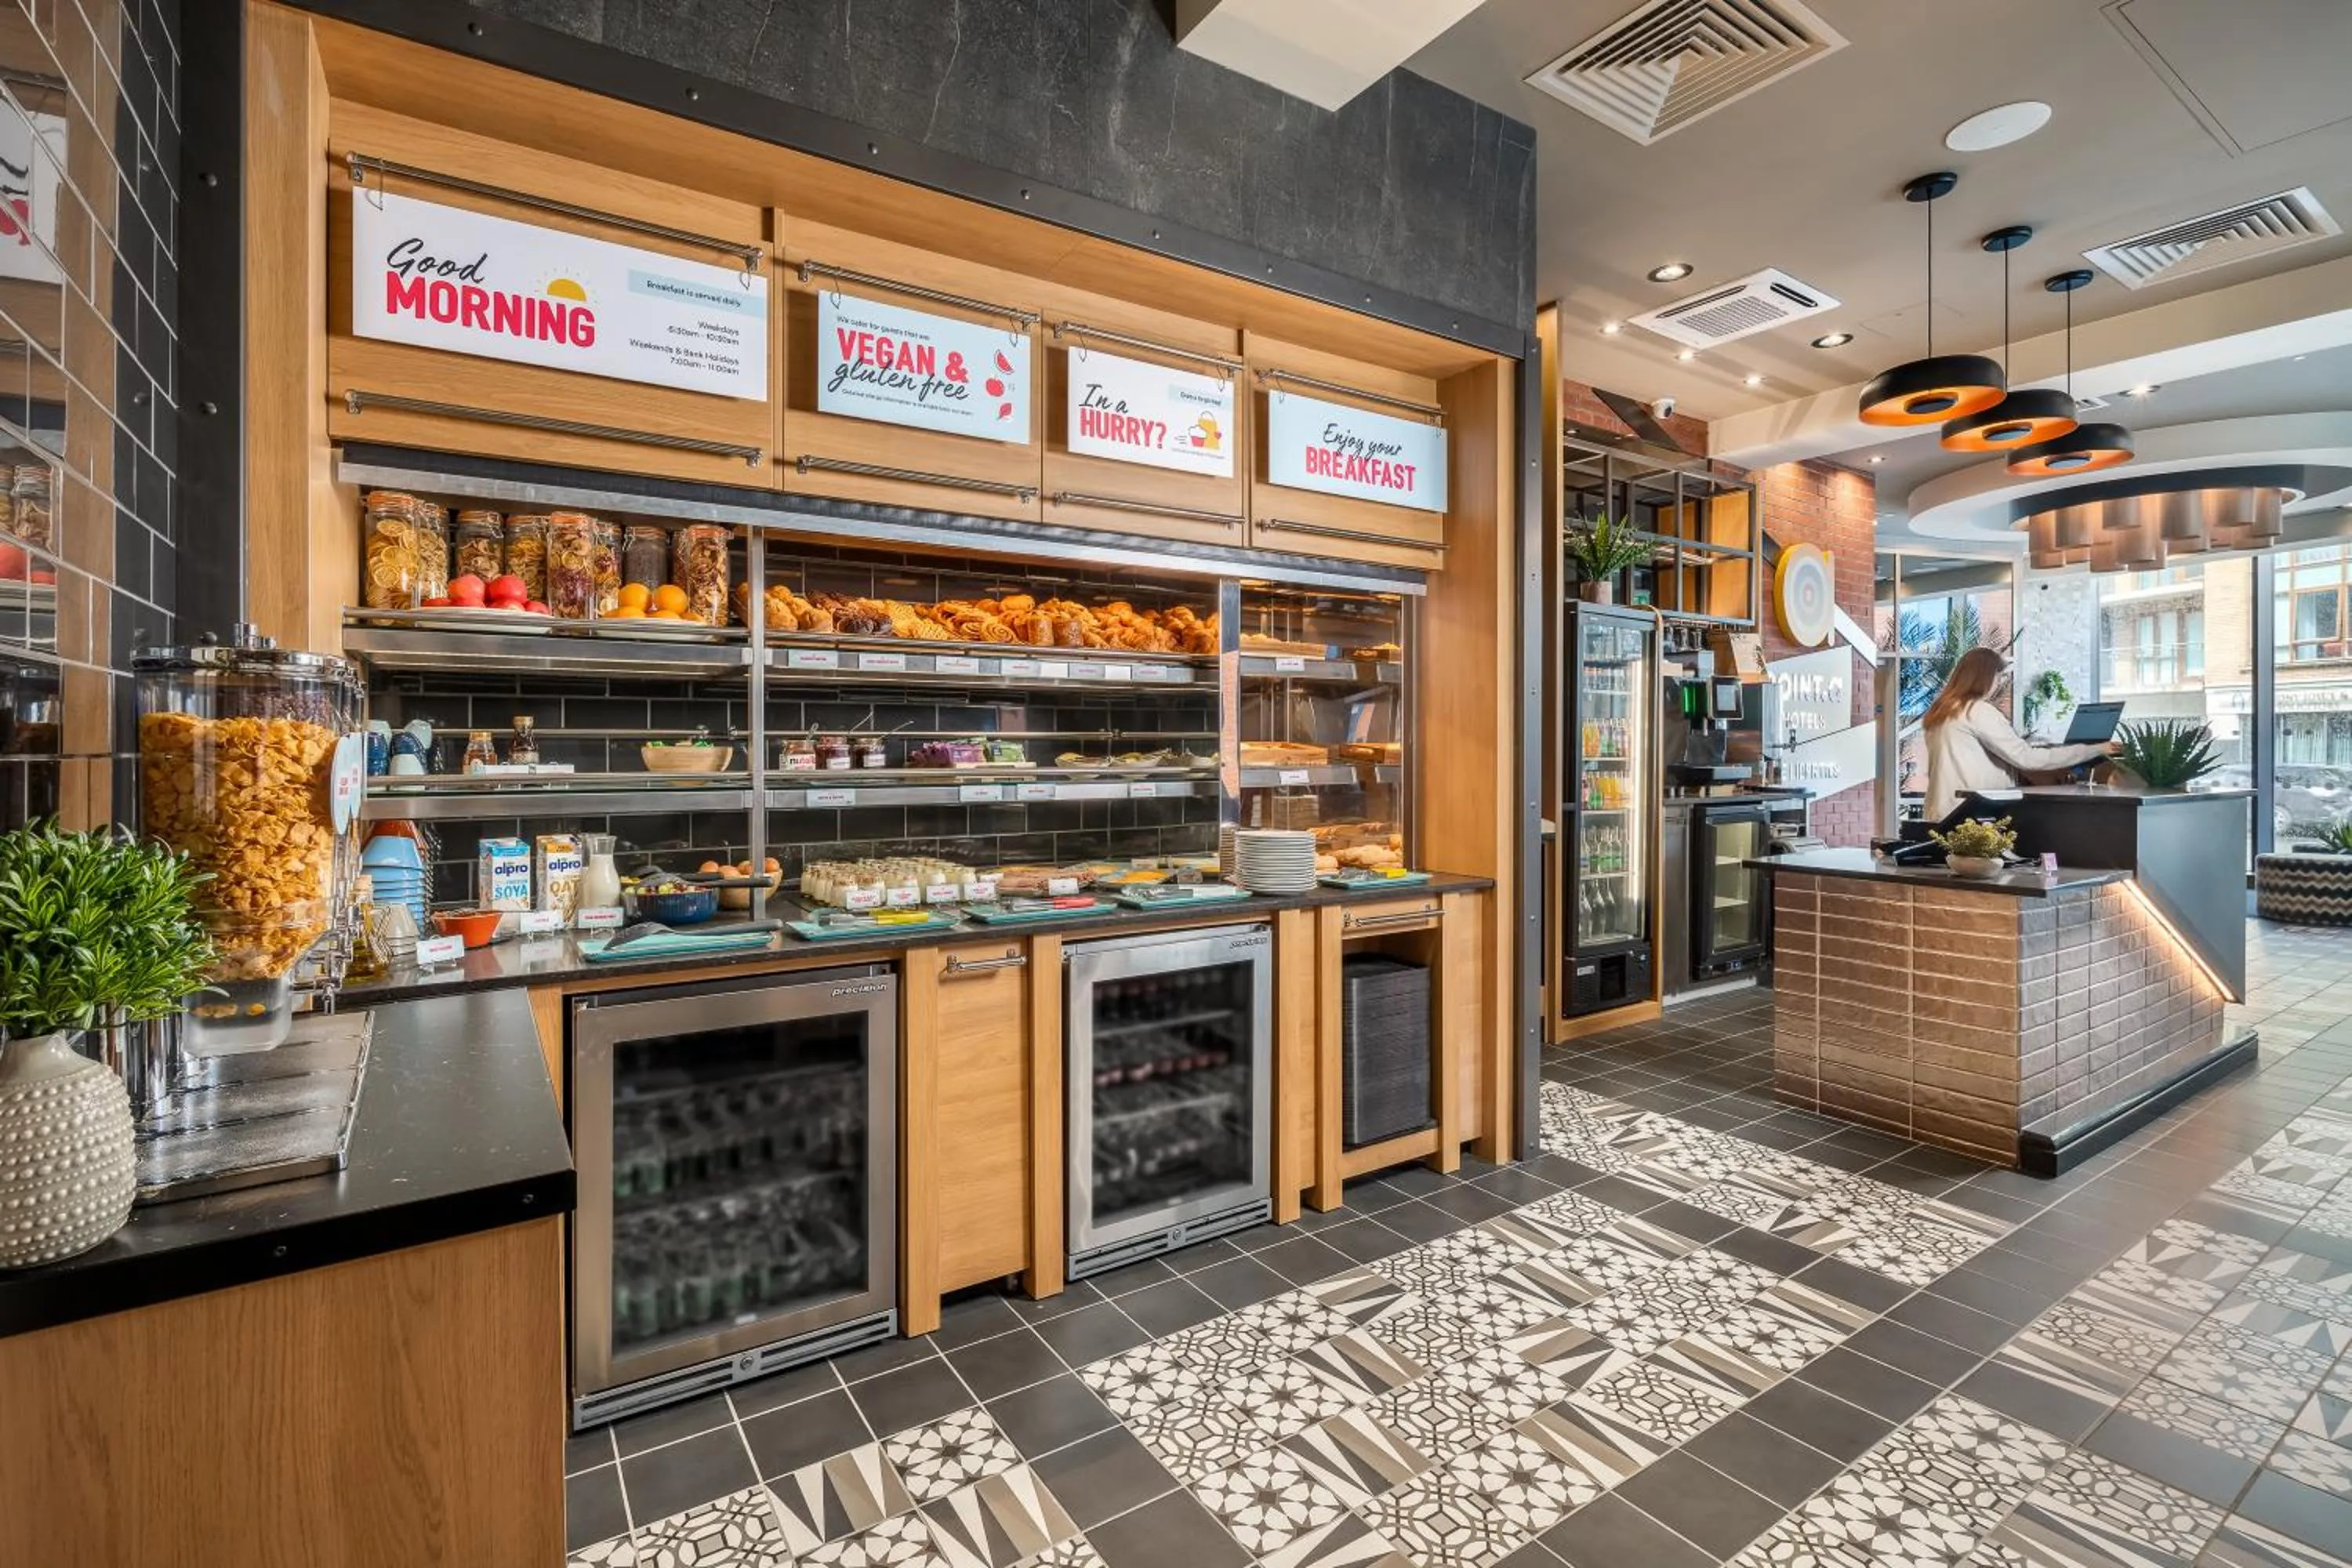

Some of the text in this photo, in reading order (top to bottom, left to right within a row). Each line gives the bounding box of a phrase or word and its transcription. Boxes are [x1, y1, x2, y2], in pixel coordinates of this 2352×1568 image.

[387, 238, 488, 284] Good
[647, 280, 685, 296] Breakfast
[387, 270, 595, 347] MORNING
[698, 320, 739, 336] Weekdays
[629, 338, 739, 366] Weekends & Bank Holidays
[837, 327, 969, 383] VEGAN &
[828, 357, 970, 401] gluten free
[1079, 384, 1128, 414] In a
[1080, 407, 1167, 449] HURRY?
[1323, 423, 1403, 462] Enjoy your
[1305, 446, 1416, 492] BREAKFAST
[495, 862, 528, 877] alpro
[549, 858, 581, 872] alpro
[495, 884, 528, 898] SOYA
